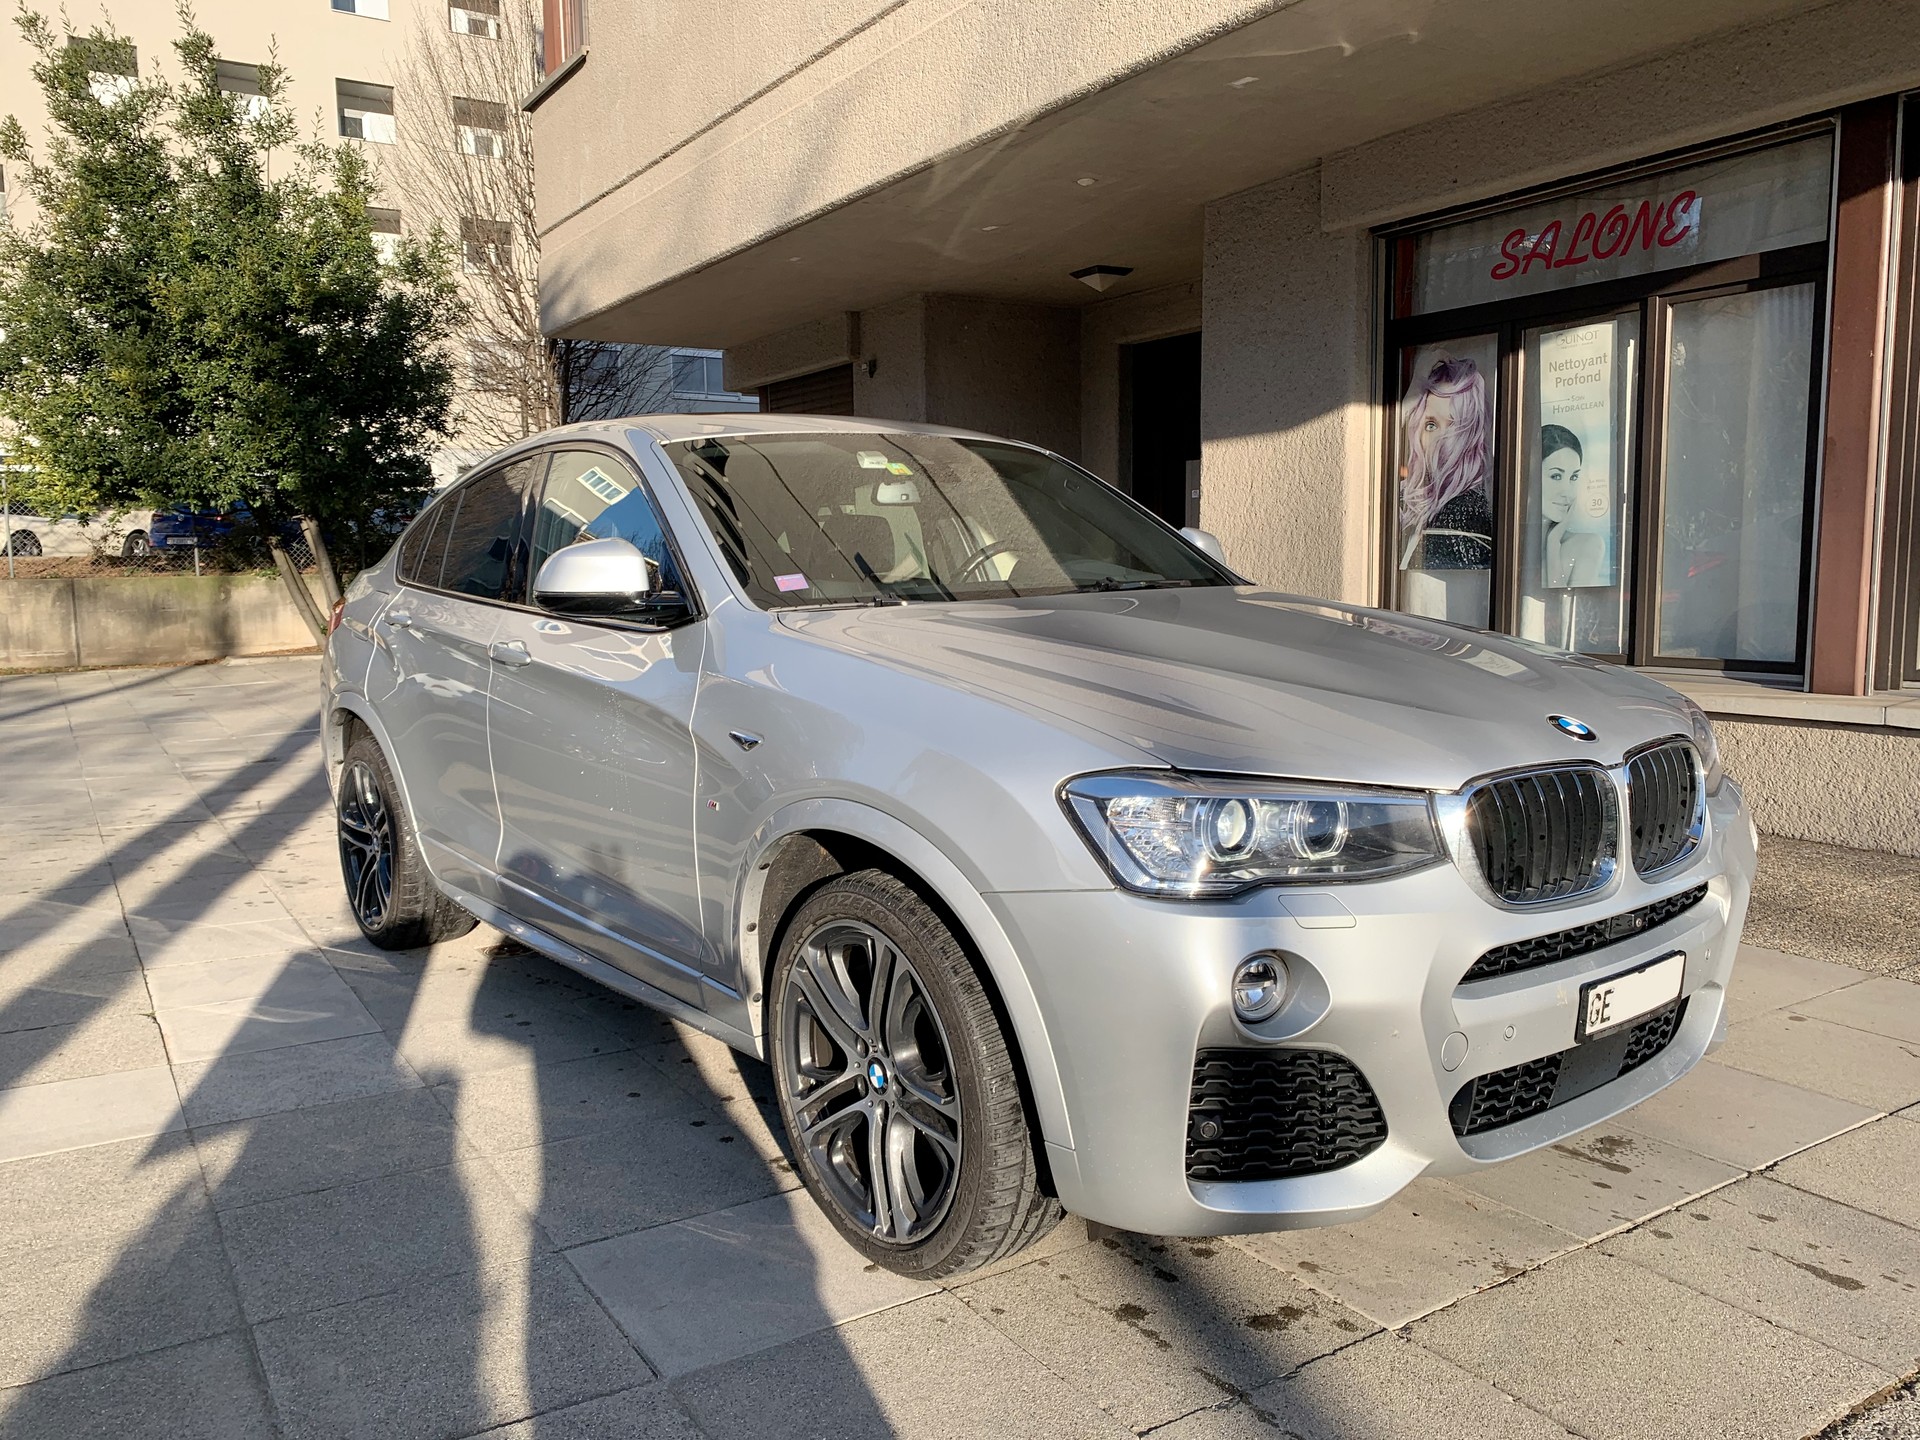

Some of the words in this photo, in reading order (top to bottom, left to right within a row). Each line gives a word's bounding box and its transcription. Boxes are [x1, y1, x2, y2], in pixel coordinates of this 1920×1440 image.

[1490, 190, 1696, 280] SALONE
[1556, 330, 1600, 346] GUINOT
[1548, 352, 1608, 373] Nettoyant
[1555, 369, 1601, 388] Profond
[1591, 498, 1603, 507] 30
[1589, 987, 1615, 1027] GE
